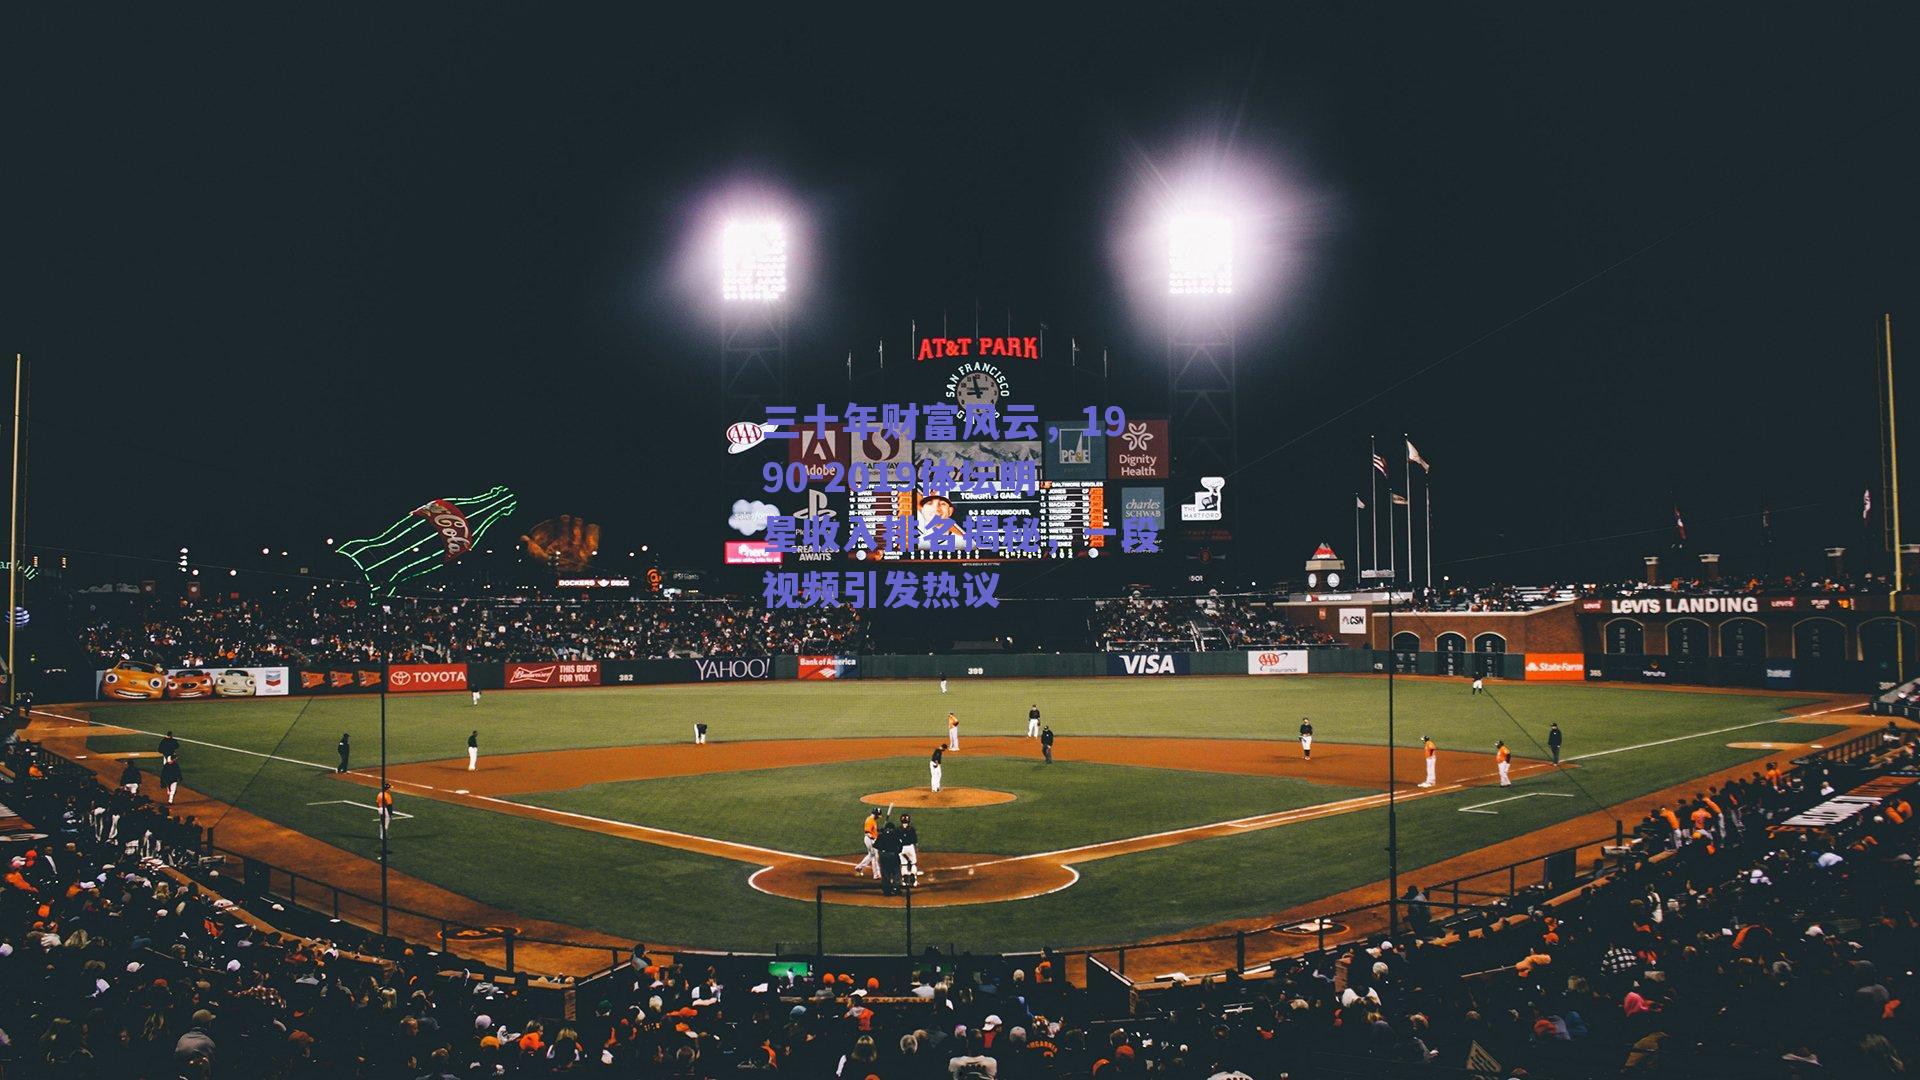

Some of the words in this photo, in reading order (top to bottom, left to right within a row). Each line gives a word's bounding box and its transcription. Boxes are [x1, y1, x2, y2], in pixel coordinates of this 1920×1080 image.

[918, 337, 972, 360] AT&T
[979, 336, 1039, 359] PARK
[946, 374, 959, 398] SAN
[958, 361, 1010, 397] FRANCISCO
[1062, 449, 1090, 463] PG&E
[1119, 454, 1157, 467] Dignity
[1121, 466, 1156, 477] Health
[1125, 498, 1160, 511] charles
[1125, 510, 1162, 518] SCHWAB
[434, 514, 471, 555] Cola
[799, 553, 832, 561] AWAITS
[1666, 597, 1758, 614] LANDING
[1350, 616, 1364, 625] CSN
[800, 658, 819, 666] Bank
[818, 658, 827, 666] of
[826, 658, 857, 666] America
[1119, 654, 1176, 675] VISA
[514, 670, 552, 679] Budweiser
[559, 665, 575, 674] THIS
[576, 664, 598, 673] BUD'S
[695, 658, 771, 679] YAHOO!
[414, 671, 467, 683] TOYOTA
[559, 674, 573, 683] FOR
[574, 673, 591, 682] YOU.
